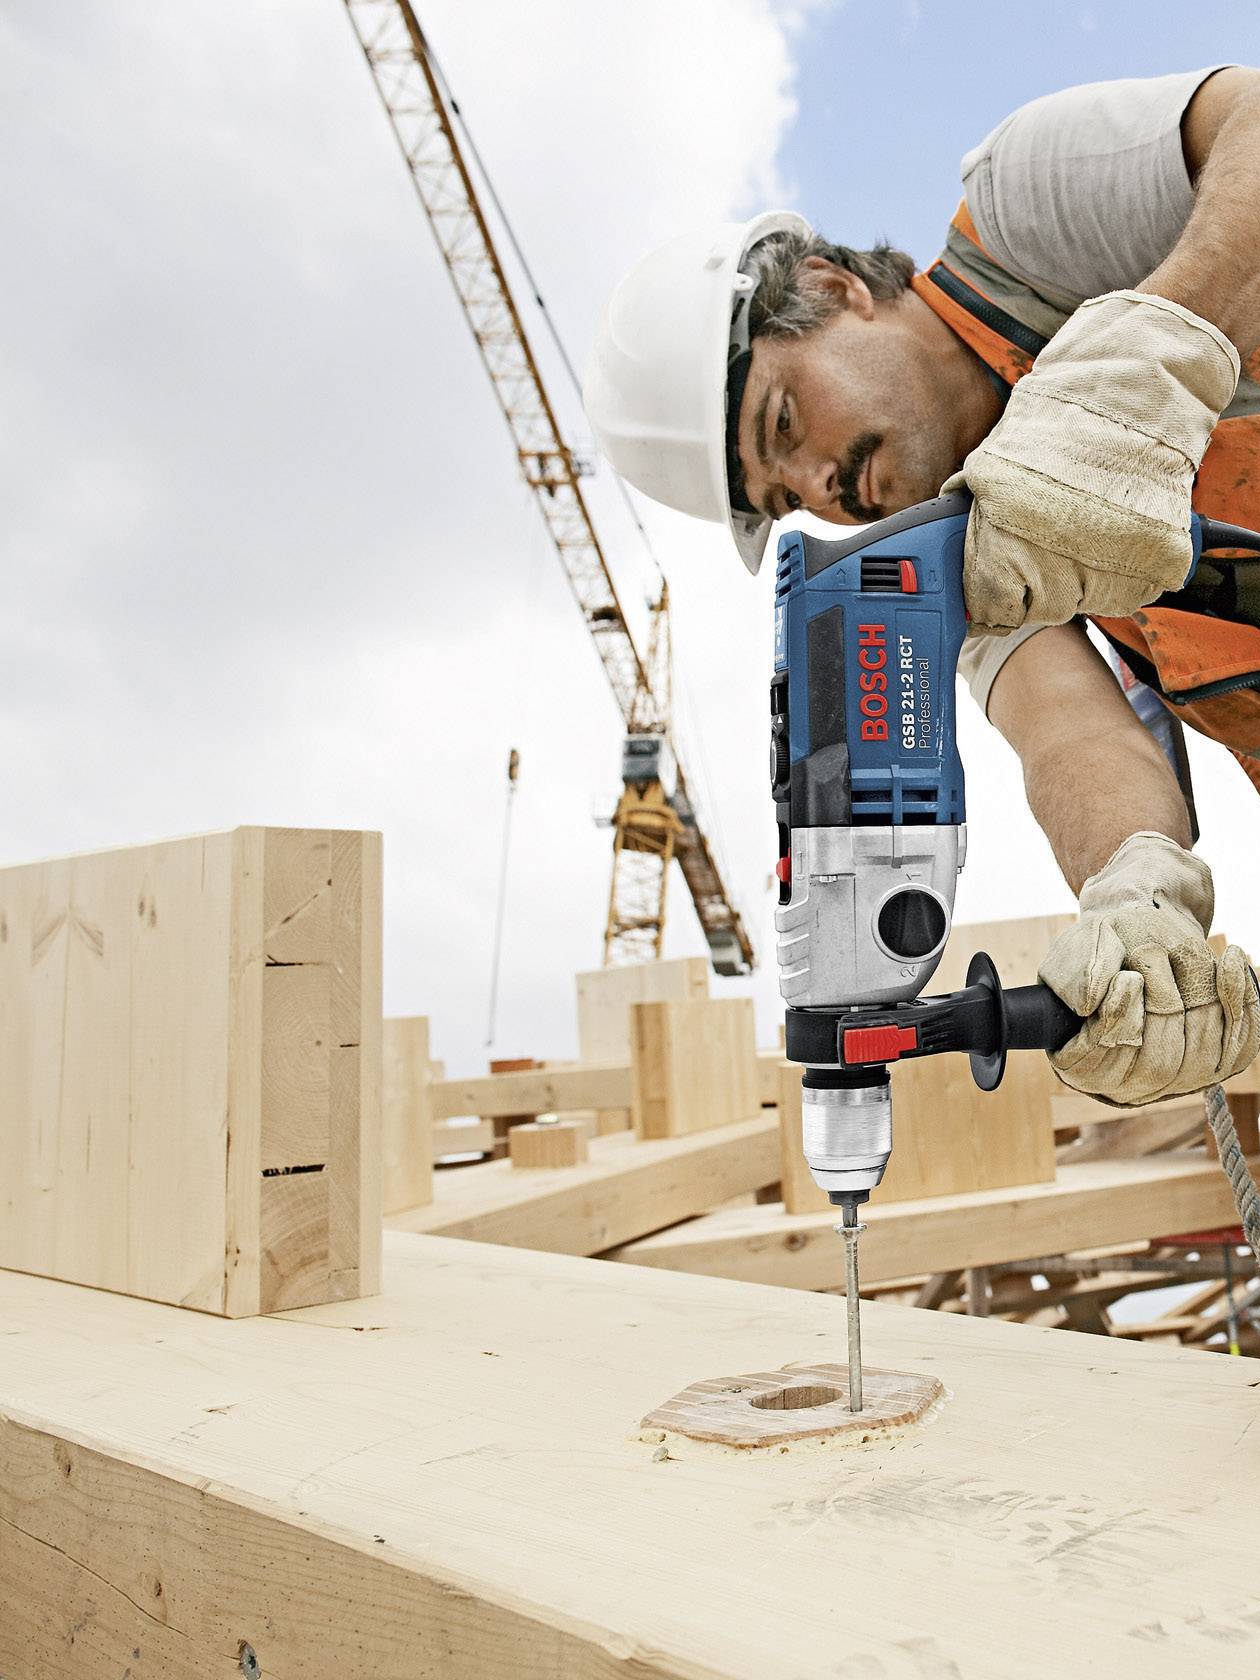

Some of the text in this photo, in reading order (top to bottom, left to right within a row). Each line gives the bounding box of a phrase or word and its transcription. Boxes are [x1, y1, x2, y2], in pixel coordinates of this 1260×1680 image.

[858, 624, 889, 741] BOSCH
[899, 635, 915, 749] GSB 21-2 RCT
[916, 657, 931, 748] Professional
[900, 966, 916, 978] 2
